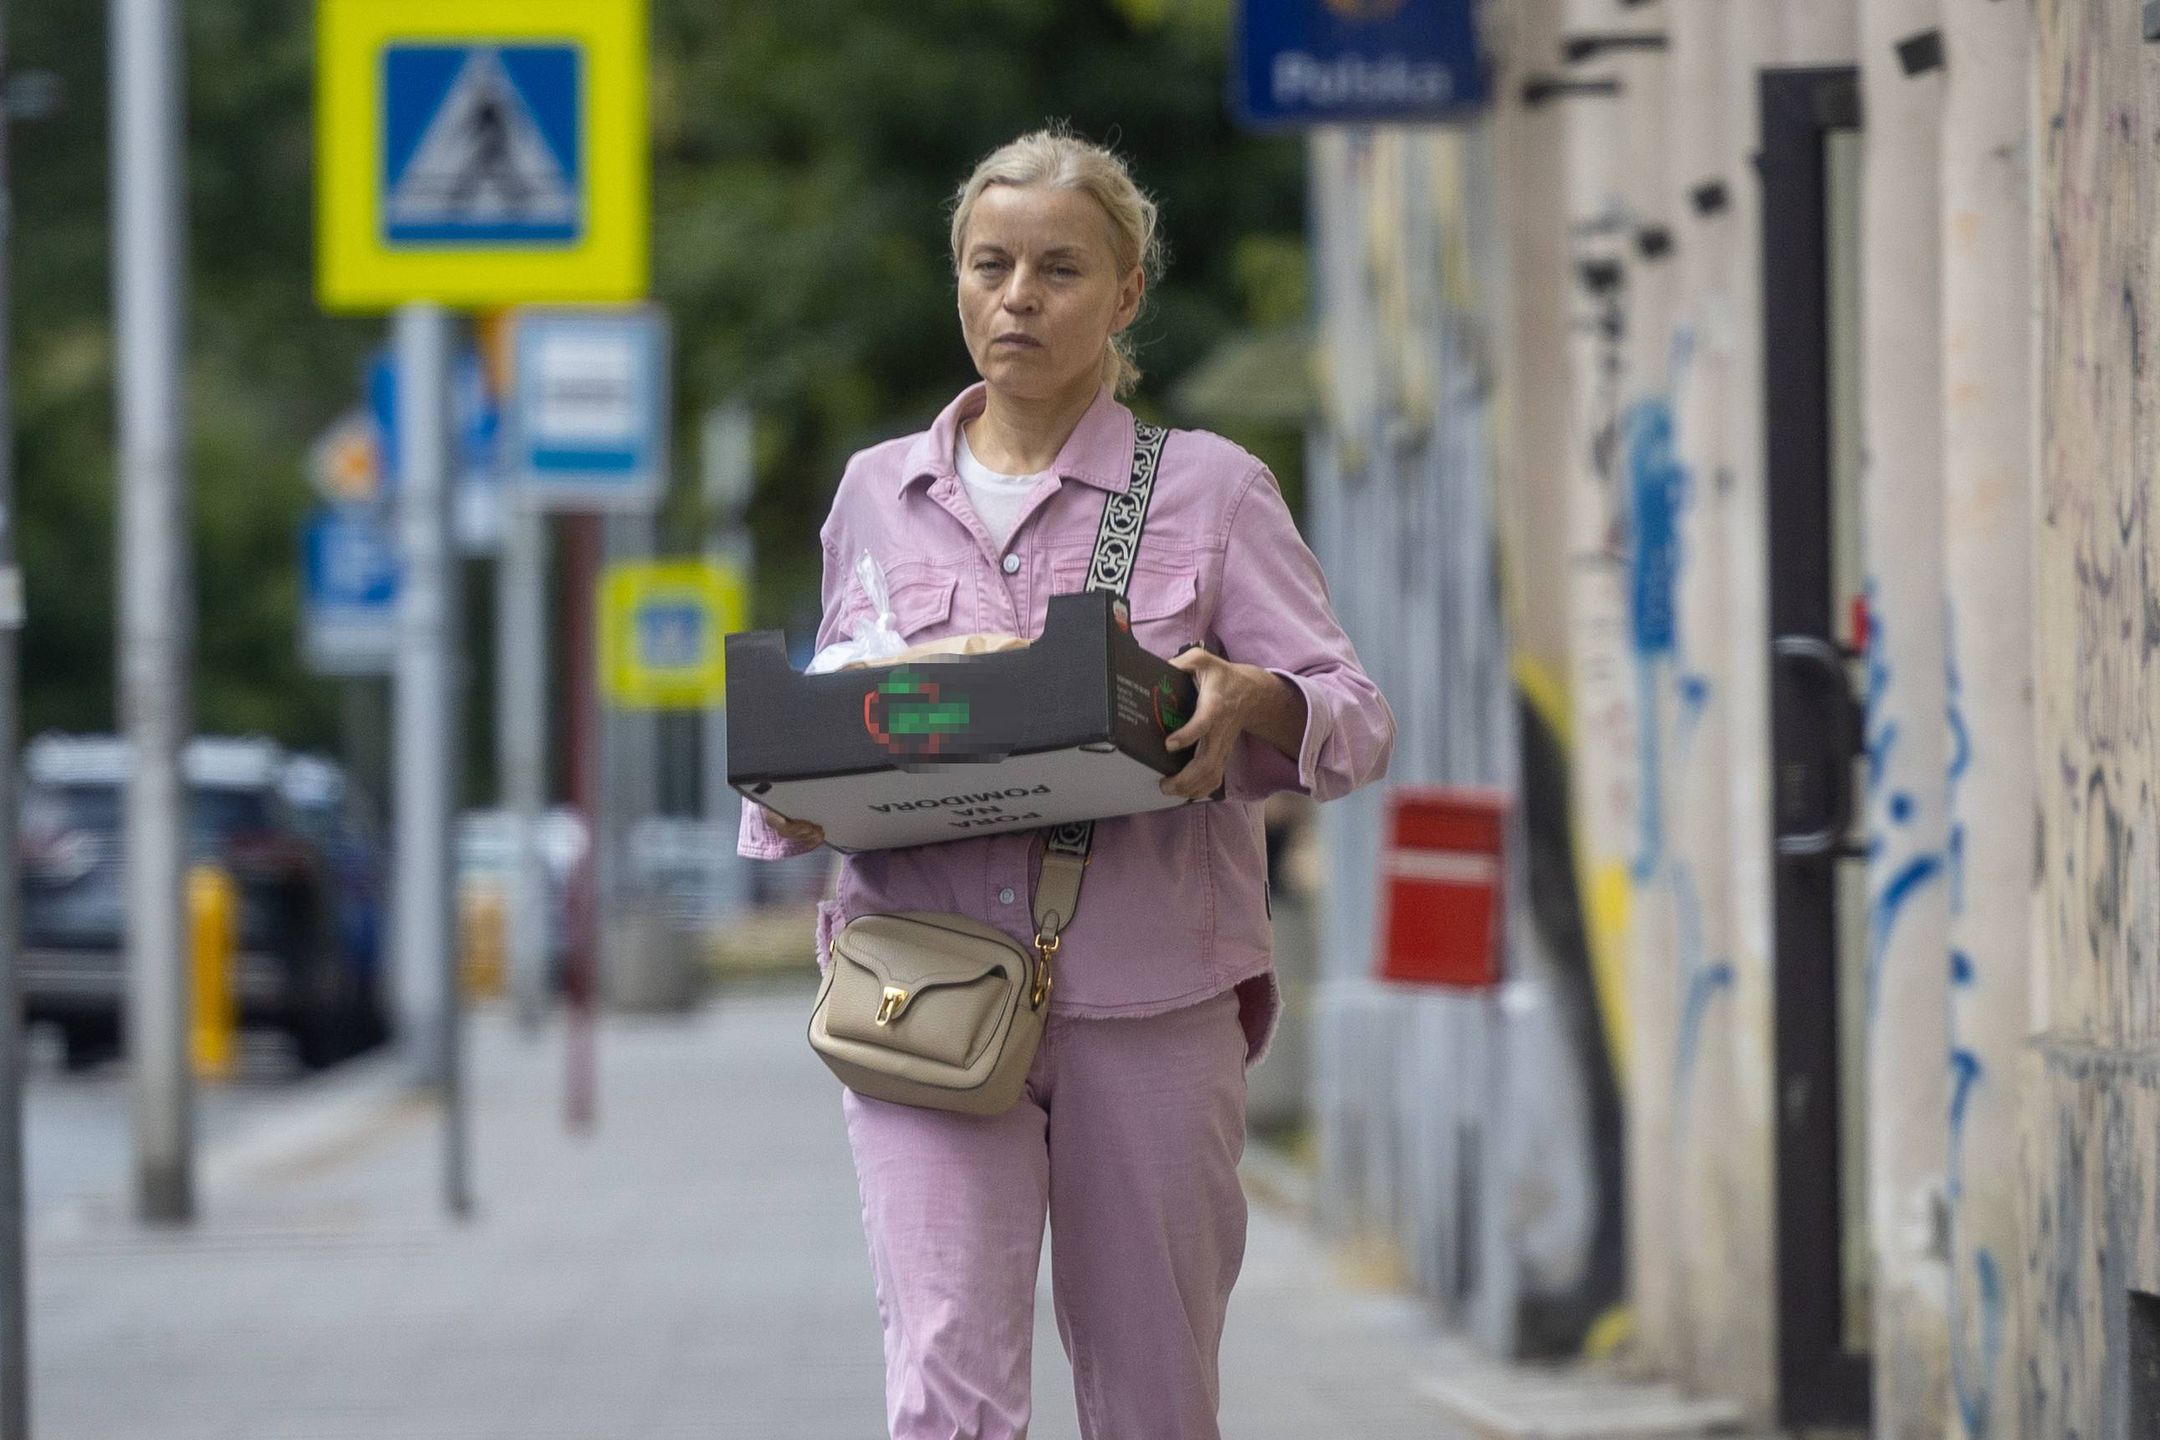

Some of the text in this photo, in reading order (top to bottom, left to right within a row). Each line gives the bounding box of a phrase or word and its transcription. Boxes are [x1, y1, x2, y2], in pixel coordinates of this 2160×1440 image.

[867, 784, 1052, 814] POMIDORA
[948, 811, 1042, 828] PORA
[951, 805, 1003, 817] NA
